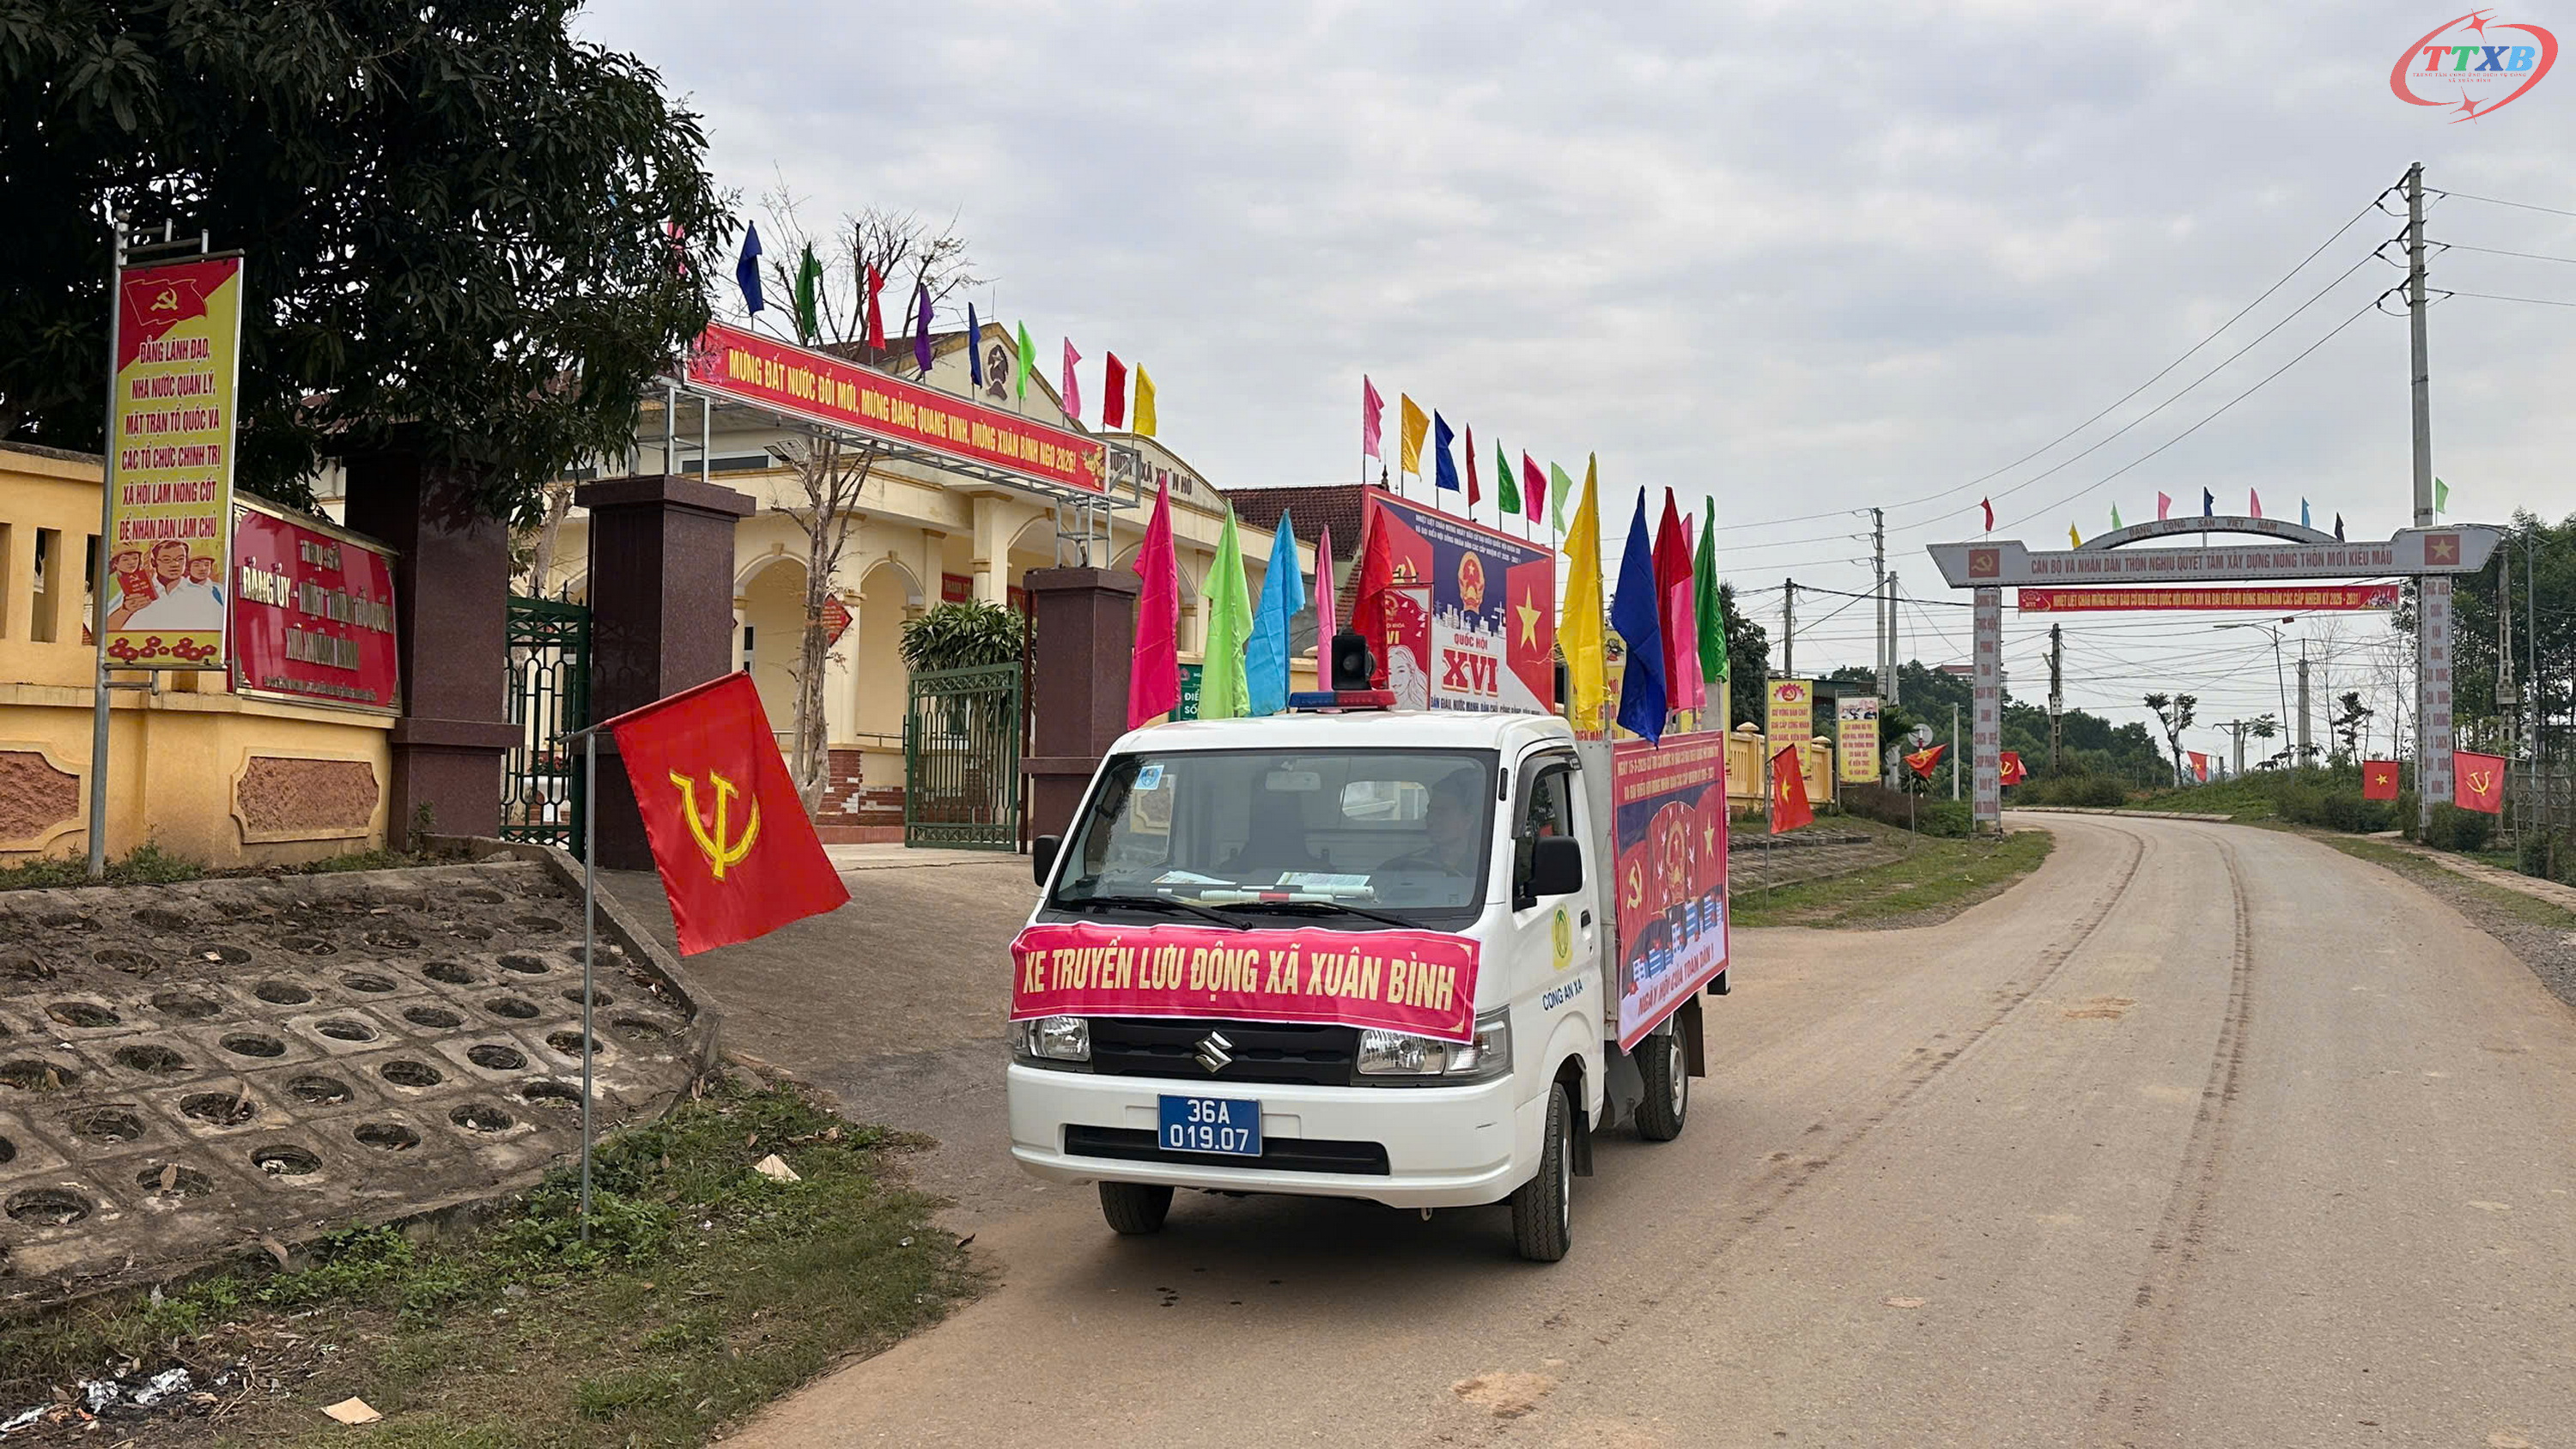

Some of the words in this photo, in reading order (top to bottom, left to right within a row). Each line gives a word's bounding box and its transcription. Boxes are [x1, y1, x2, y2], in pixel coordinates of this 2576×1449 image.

[139, 335, 163, 364] ĐẢNG
[165, 336, 189, 362] LÃNH
[190, 337, 210, 363] ĐẠO,
[131, 374, 149, 400] NHÀ
[151, 373, 175, 398] NƯỚC
[177, 367, 202, 398] QUẢN
[203, 368, 216, 396] LÝ,
[125, 410, 144, 439] MẶT
[146, 409, 168, 438] TRẬN
[169, 403, 182, 433] TỔ
[182, 403, 207, 434] QUỐC
[208, 403, 220, 430] VÀ
[729, 347, 762, 386] MỪNG
[764, 353, 786, 393] ĐẤT
[787, 364, 816, 402] NƯỚC
[817, 367, 835, 407] ĐỔI
[837, 379, 859, 417] MỚI,
[861, 385, 889, 422] MỪNG
[890, 391, 916, 430] ĐẢNG
[917, 404, 946, 440] QUANG
[948, 414, 970, 447] VINH,
[971, 418, 996, 452] MỪNG
[997, 427, 1019, 458] XUÂN
[1019, 432, 1039, 464] BÍNH
[1040, 441, 1056, 474] NGỌ
[1056, 446, 1077, 475] 2026!
[121, 445, 139, 471] CÁC
[140, 440, 152, 470] TỔ
[153, 443, 176, 470] CHỨC
[177, 442, 206, 468] CHÍNH
[207, 444, 222, 470] TRỊ
[122, 480, 135, 506] XÃ
[136, 480, 151, 510] HỘI
[152, 479, 171, 505] LÀM
[173, 477, 198, 504] NÒNG
[199, 473, 217, 502] CỐT
[118, 512, 131, 542] ĐỂ
[131, 514, 157, 541] NHÂN
[158, 514, 176, 540] DÂN
[177, 513, 197, 539] LÀM
[198, 509, 217, 538] CHỦ
[2257, 520, 2279, 531] NAM
[2078, 555, 2102, 573] NHÂN
[2104, 554, 2122, 573] DÂN
[2124, 553, 2147, 573] THÔN
[2206, 551, 2224, 570] TÂM
[2227, 551, 2244, 570] XÂY
[2246, 552, 2271, 573] DỰNG
[2272, 549, 2298, 568] NÔNG
[2300, 548, 2324, 568] THÔN
[240, 556, 274, 605] ĐẢNG
[1454, 632, 1473, 647] QUỐC
[1475, 635, 1488, 651] HỘI
[1443, 646, 1499, 698] XVI
[1023, 950, 1047, 994] XE
[1139, 943, 1186, 991] LƯU
[1189, 940, 1260, 1002] ĐỘNG
[1265, 943, 1301, 995] XÃ
[1306, 946, 1382, 1002] XUÂN
[1387, 951, 1456, 1011] BÌNH
[1564, 982, 1574, 1002] AN
[1187, 1099, 1230, 1125] 36A
[1170, 1124, 1249, 1152] 019.07
